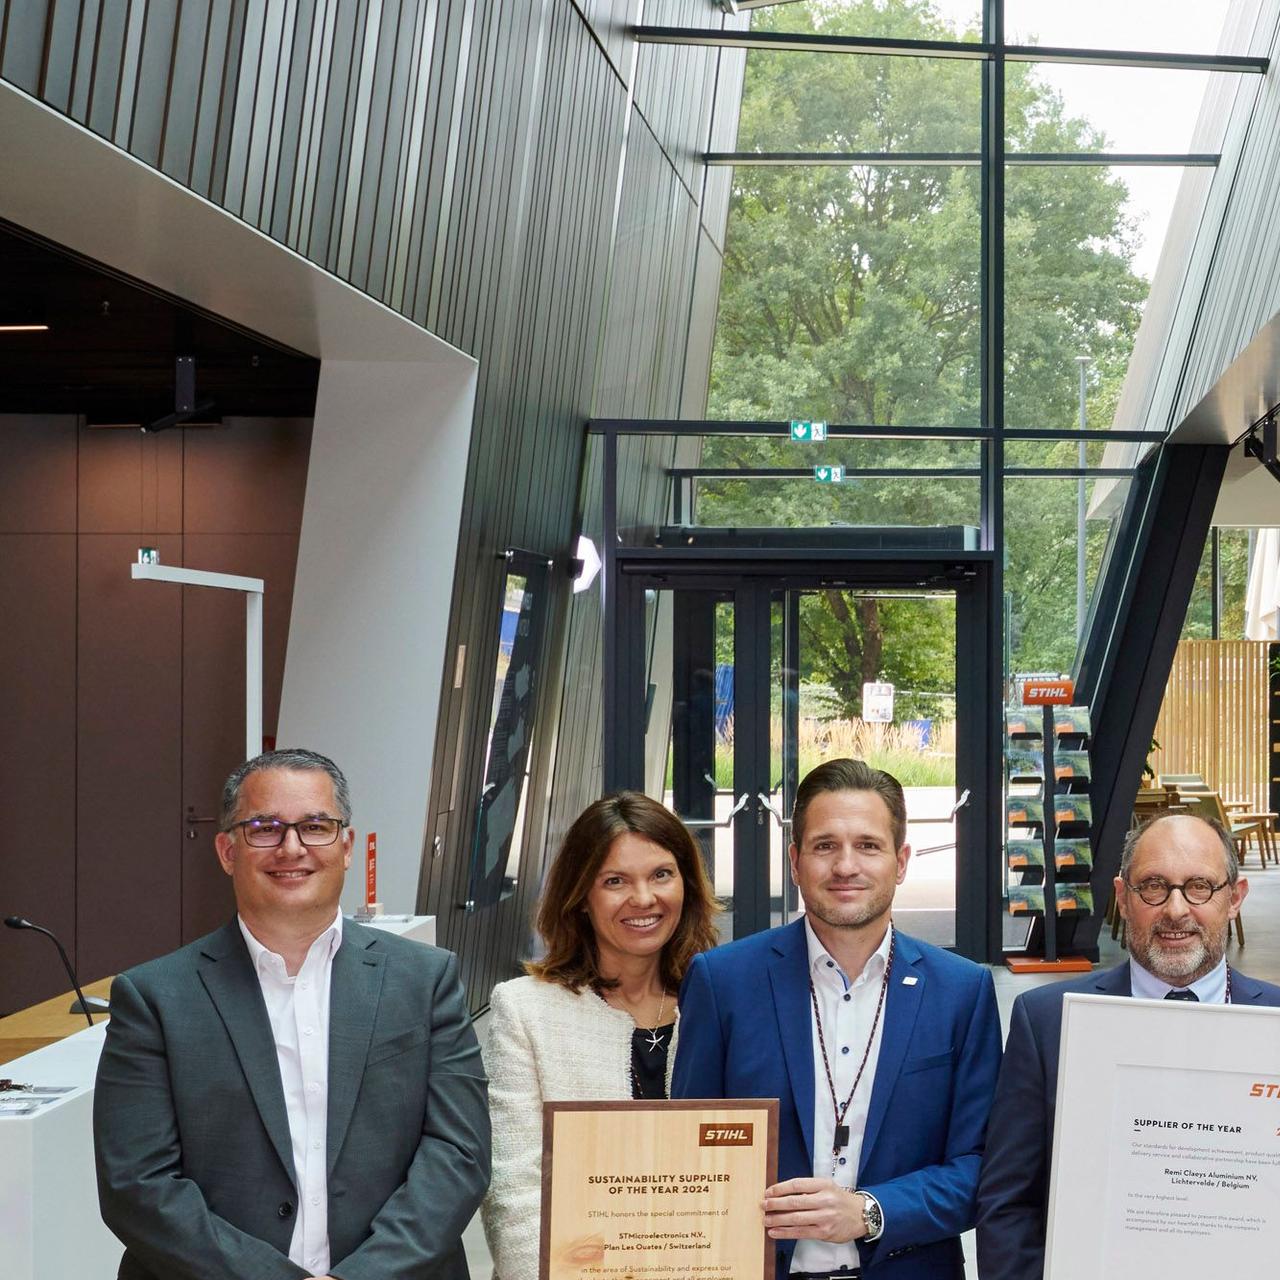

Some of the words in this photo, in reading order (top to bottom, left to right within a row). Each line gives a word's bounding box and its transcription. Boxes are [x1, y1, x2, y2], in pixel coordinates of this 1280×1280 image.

[1029, 688, 1068, 697] STIHL
[1134, 1119, 1178, 1129] SUPPLIER
[1197, 1124, 1214, 1132] THE
[1218, 1125, 1242, 1133] YEAR
[705, 1130, 748, 1139] STIHL
[1164, 1168, 1182, 1176] Remi
[1184, 1170, 1206, 1178] Claeys
[1208, 1172, 1244, 1180] Aluminium
[588, 1175, 675, 1184] SUSTAINABILITY
[679, 1174, 730, 1183] SUPPLIER
[1171, 1178, 1214, 1187] Lichtervelde
[1222, 1181, 1250, 1189] Belgium
[627, 1186, 647, 1194] THE
[652, 1186, 678, 1194] YEAR
[650, 1210, 674, 1218] special
